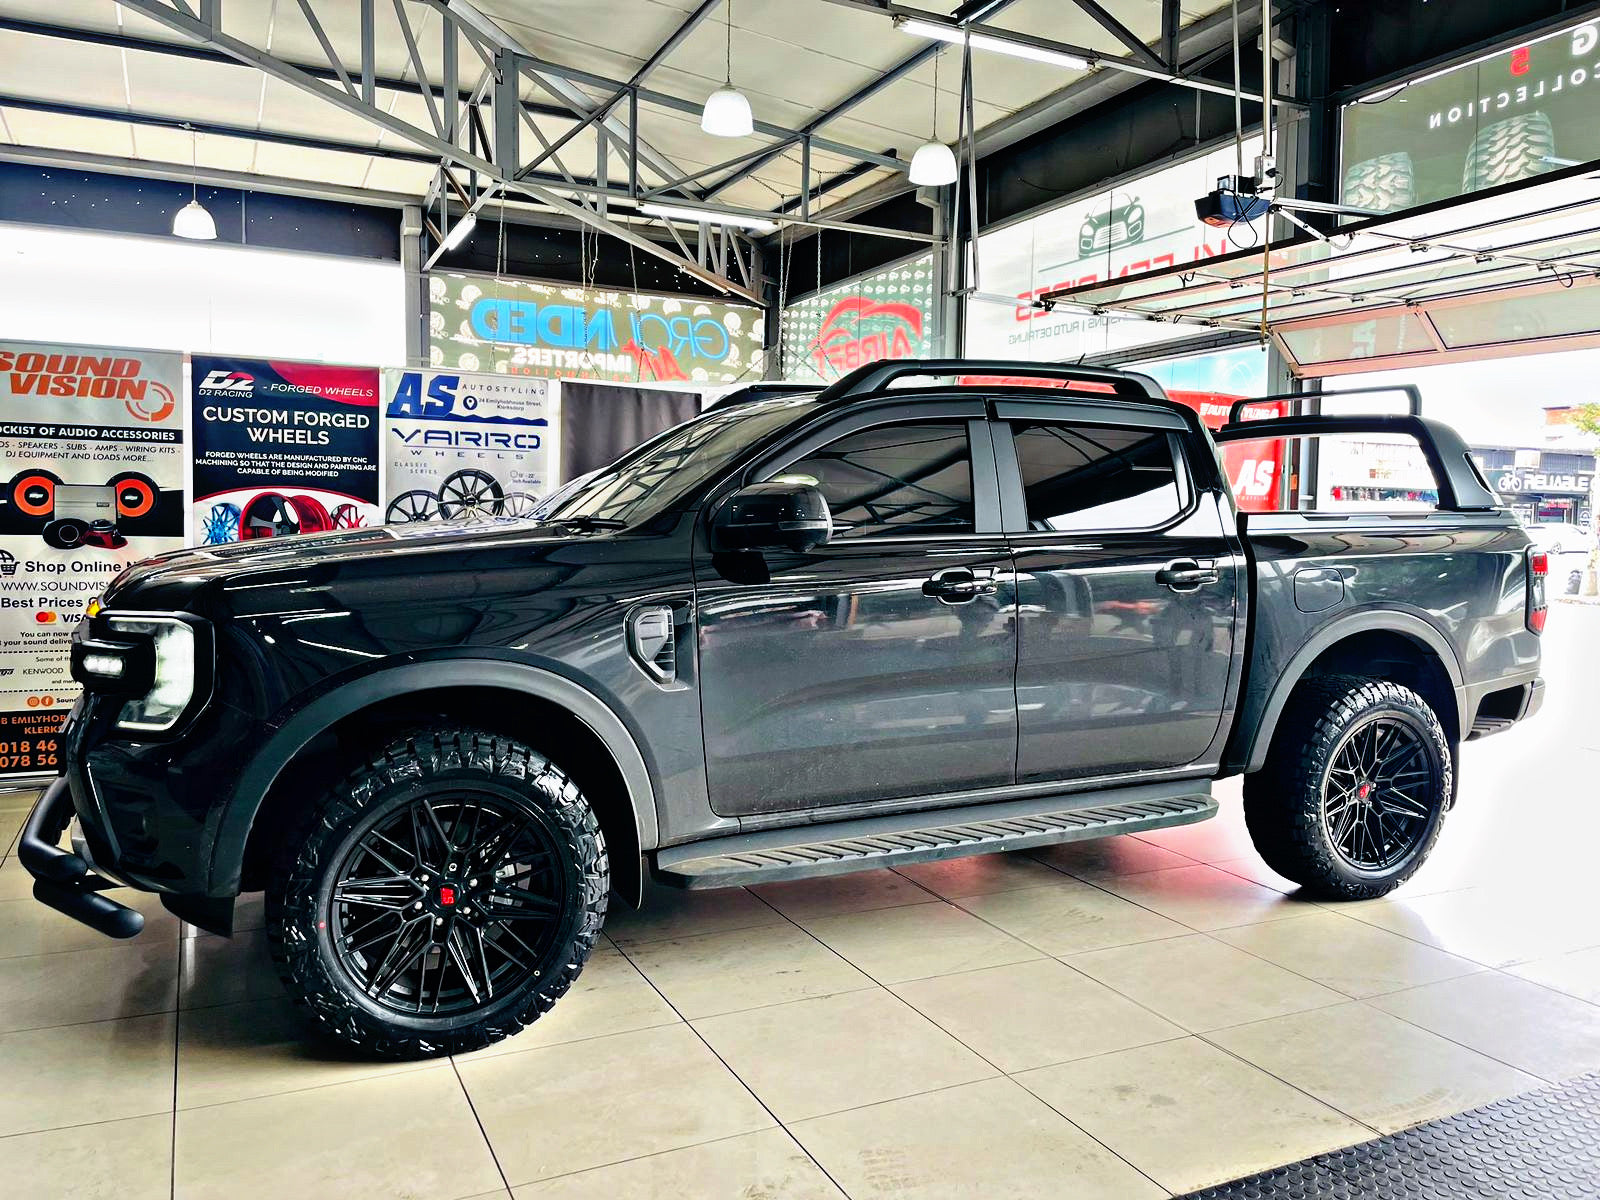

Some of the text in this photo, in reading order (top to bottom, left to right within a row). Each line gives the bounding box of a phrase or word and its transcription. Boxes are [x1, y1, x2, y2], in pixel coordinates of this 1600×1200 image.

[10, 372, 148, 400] VISION
[198, 388, 253, 399] D2 RACING
[271, 383, 374, 397] FORGED WHEELS
[462, 383, 545, 396] AUTOSTYLING
[387, 372, 461, 416] AS
[203, 406, 370, 429] CUSTOM FORGED
[39, 426, 56, 436] OF
[58, 427, 98, 438] AUDIO
[101, 429, 175, 441] ACCESSORIES
[247, 427, 330, 446] WHEELS
[392, 427, 541, 450] VARRO
[18, 441, 58, 450] SPEAKERS
[66, 443, 87, 451] SUBS
[95, 444, 118, 452] AMPS
[125, 445, 157, 453] WIRING
[158, 446, 176, 454] KITS
[410, 449, 524, 460] WHEELS
[6, 450, 16, 458] DJ
[18, 450, 70, 459] EQUIPMENT
[71, 452, 91, 460] AND
[93, 453, 121, 461] LOADS
[205, 450, 368, 464] FORGED WHEELS ARE MANUFACTURED BY CNC
[195, 457, 377, 472] MACHINING SO THAT THE DESIGN AND PAINTING ARE
[237, 467, 339, 478] CAPABLE OF BEING MODIFIED
[1232, 459, 1275, 496] AS
[25, 560, 66, 575] Shop
[71, 561, 121, 573] Online
[1, 597, 34, 608] Best
[38, 596, 84, 608] Prices
[22, 667, 64, 676] KENWOOD
[0, 739, 58, 754] 018 46
[0, 753, 58, 768] 078 56
